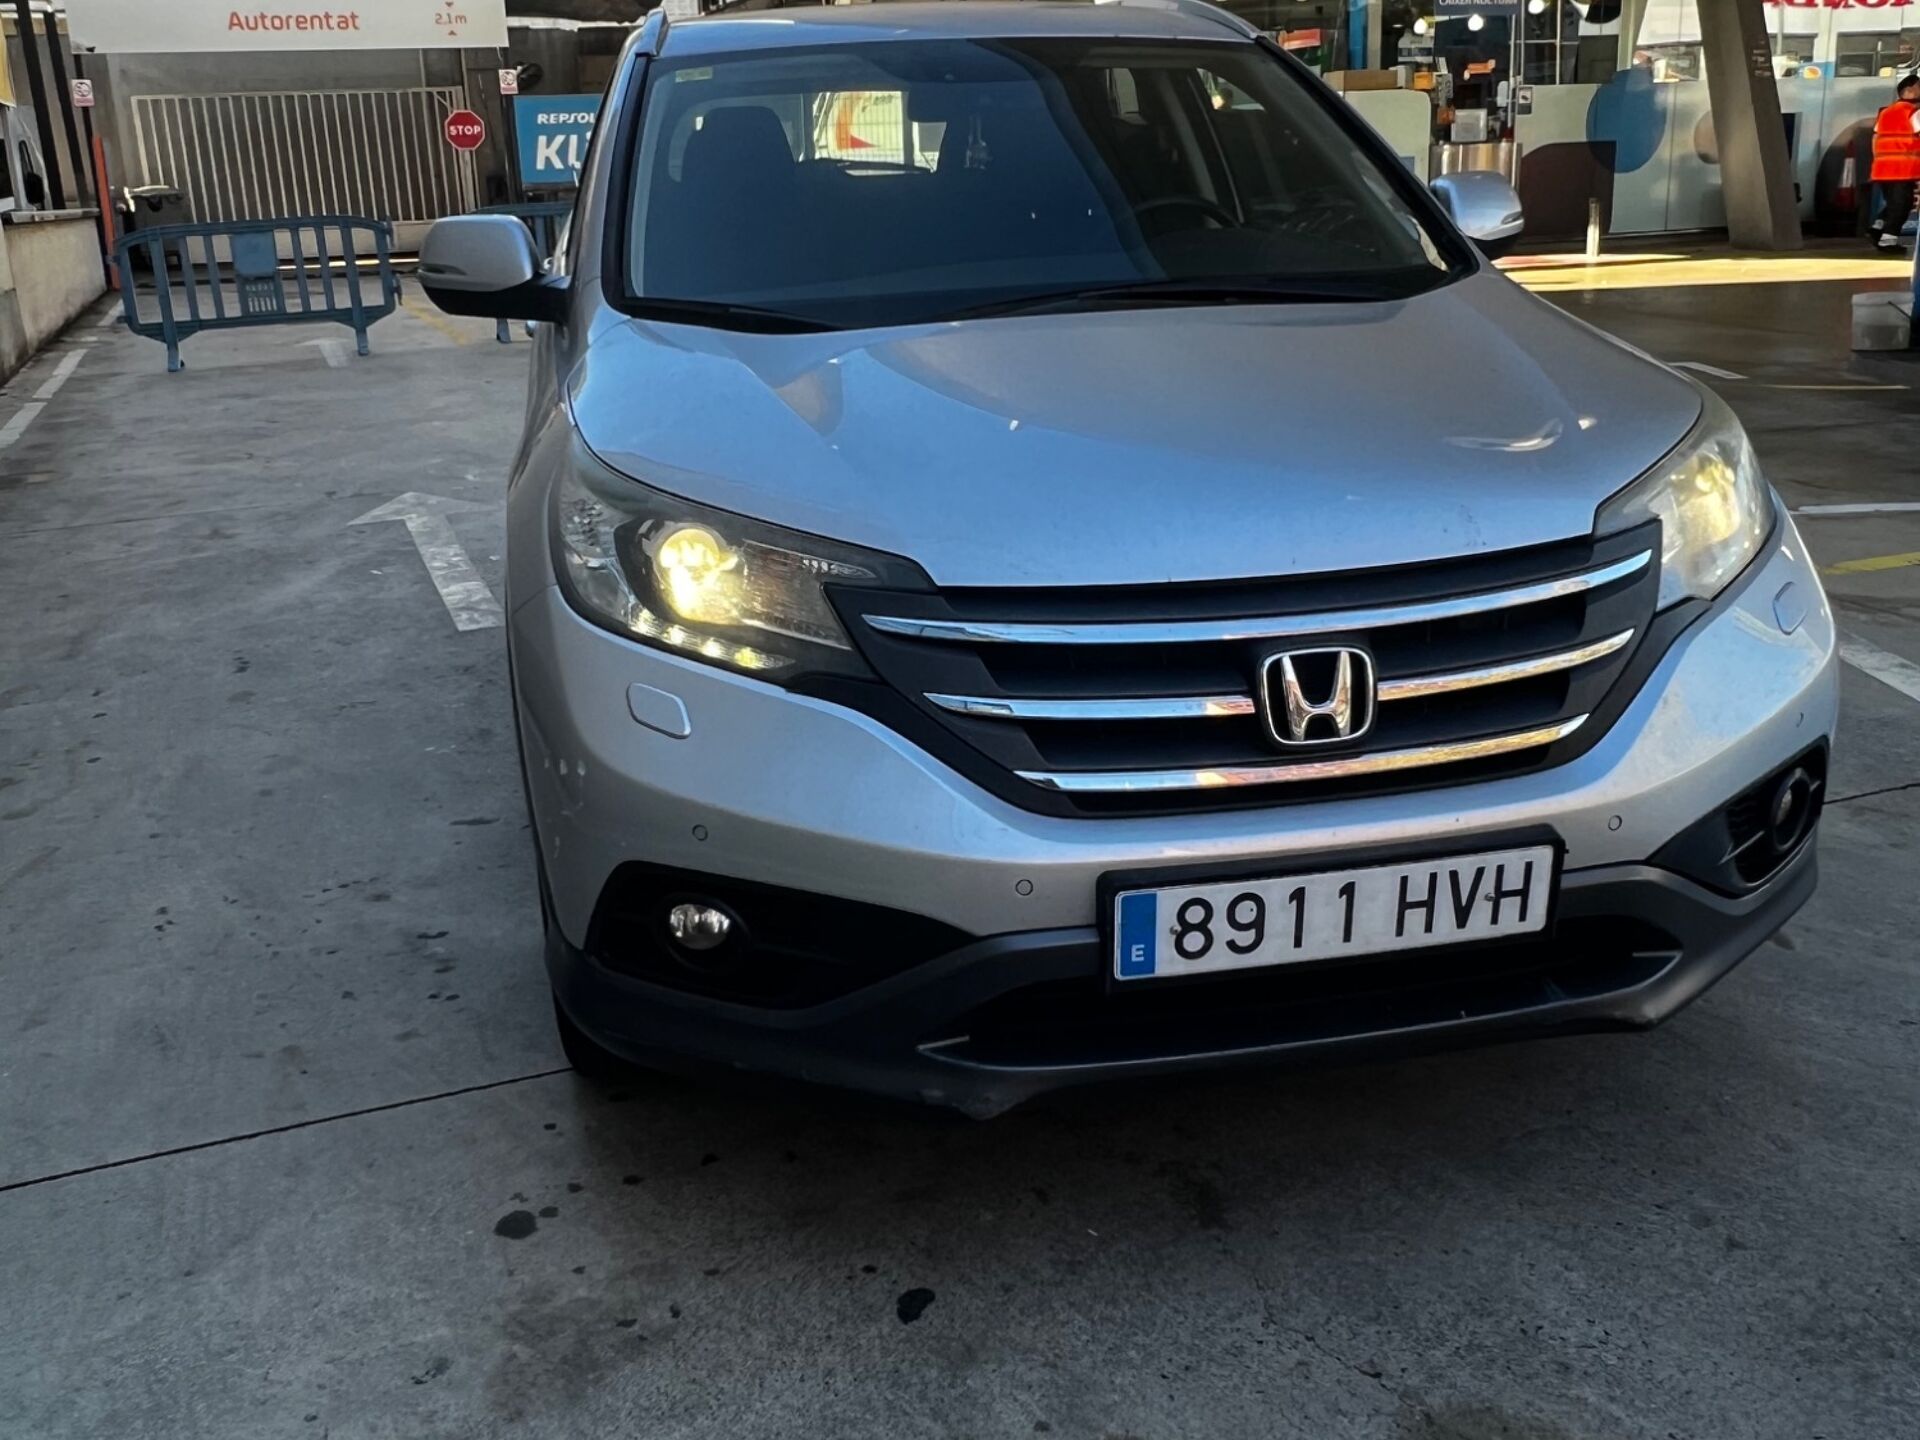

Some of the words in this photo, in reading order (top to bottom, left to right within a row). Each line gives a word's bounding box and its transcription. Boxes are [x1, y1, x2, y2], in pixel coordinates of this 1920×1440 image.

[228, 11, 360, 31] Autorentat
[449, 124, 482, 136] STOP
[536, 131, 592, 170] KL
[1173, 880, 1356, 961] 8911
[1395, 860, 1534, 938] HVH
[1130, 943, 1145, 962] E
